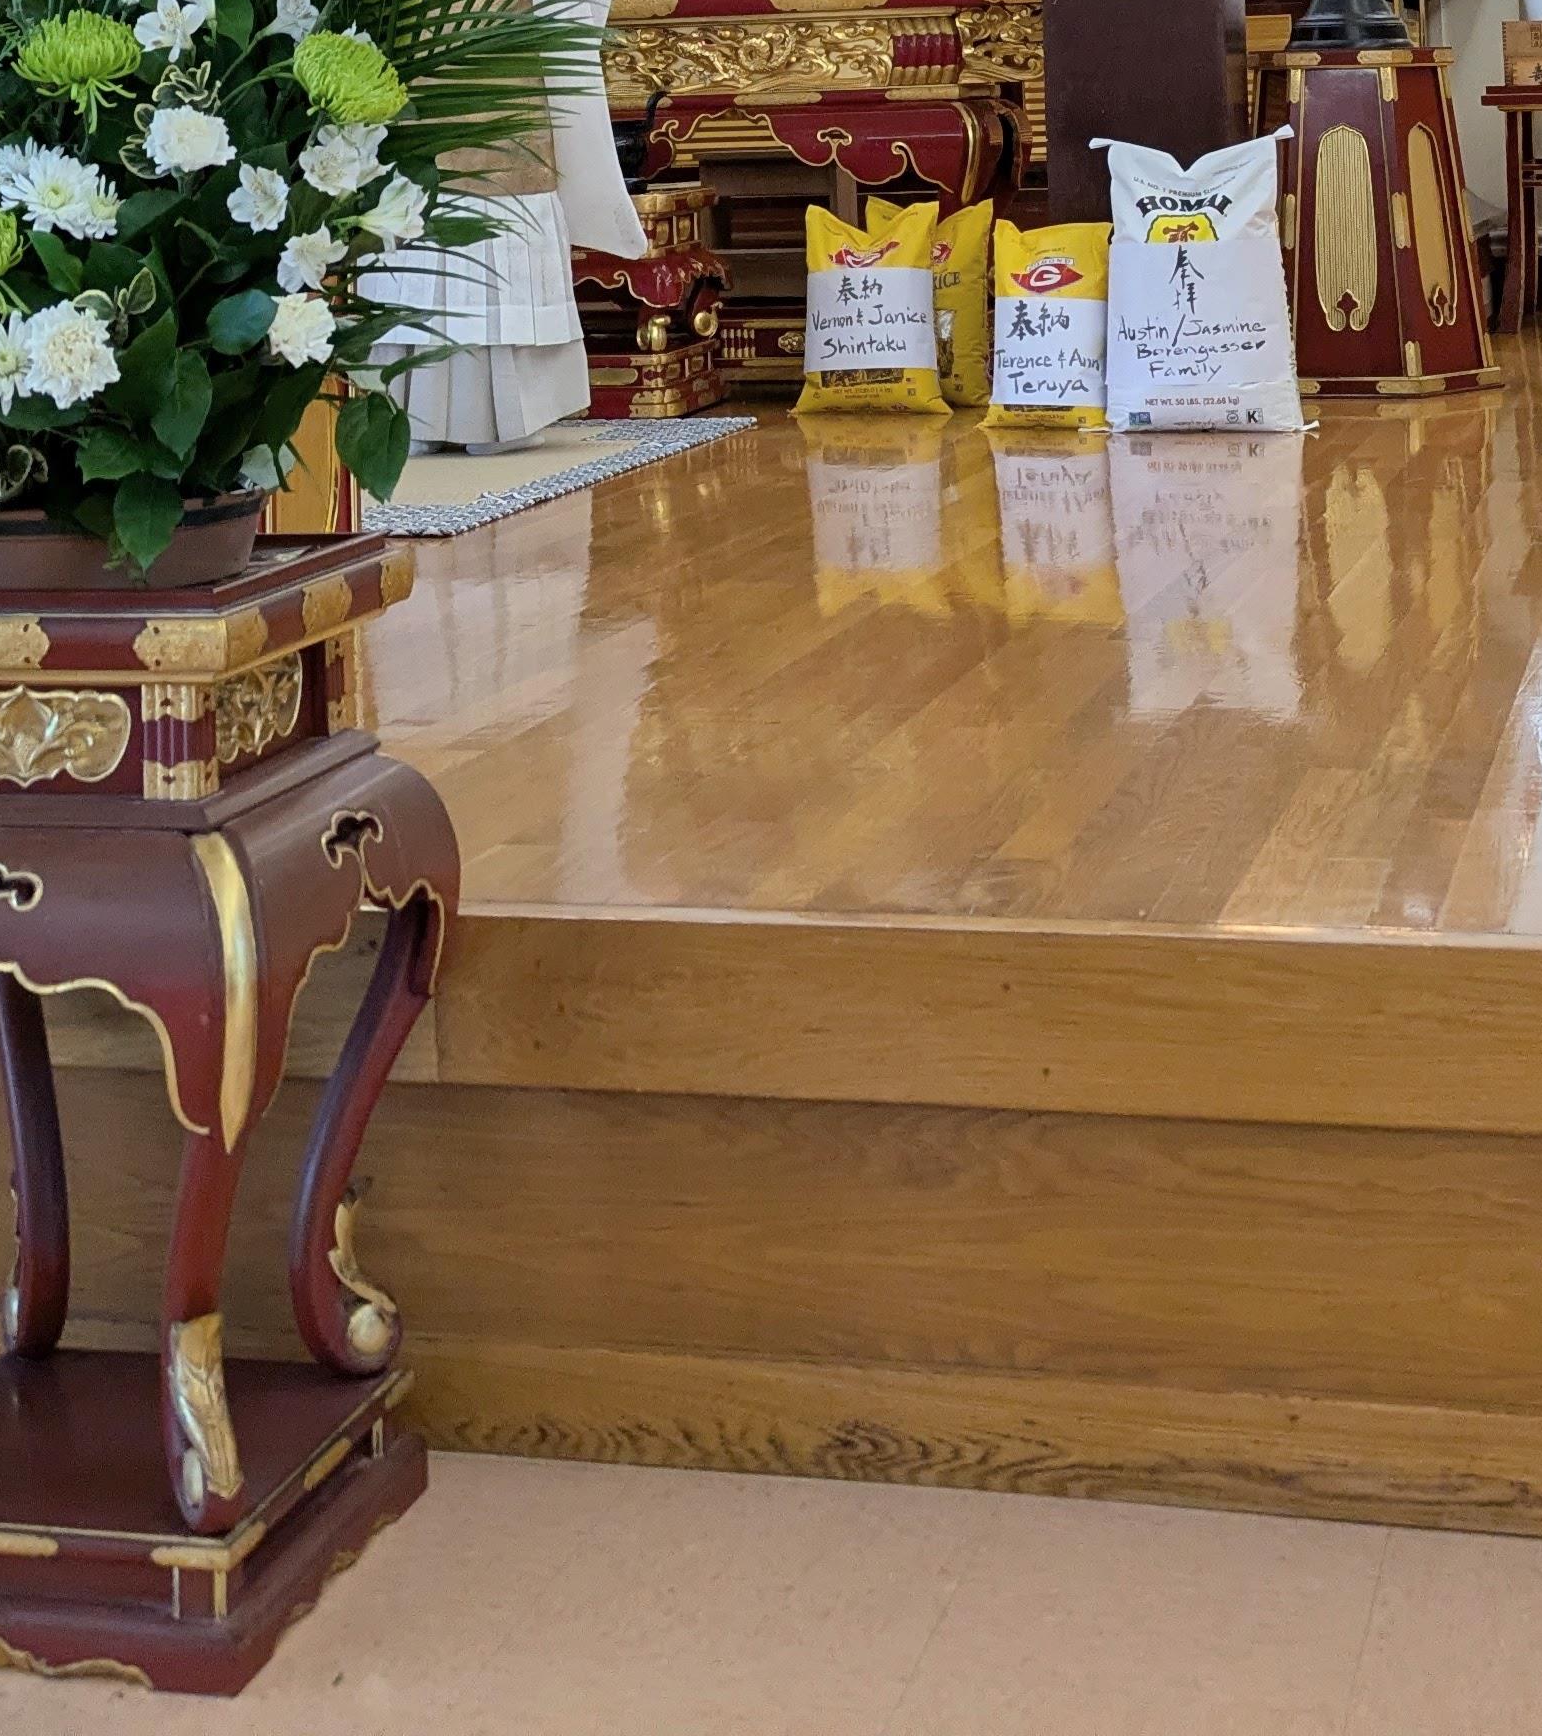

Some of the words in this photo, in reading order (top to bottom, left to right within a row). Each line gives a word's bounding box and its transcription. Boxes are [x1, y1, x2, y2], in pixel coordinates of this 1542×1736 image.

[1168, 188, 1202, 198] PREMIUM
[812, 311, 853, 331] Vernon
[868, 304, 927, 326] Janice
[820, 332, 907, 360] Shintaku
[996, 349, 1053, 370] Terence
[1068, 347, 1100, 371] Ann
[1149, 360, 1222, 383] Family
[1008, 371, 1089, 398] Teruya
[1145, 398, 1159, 406] NET
[1228, 396, 1240, 406] kg)
